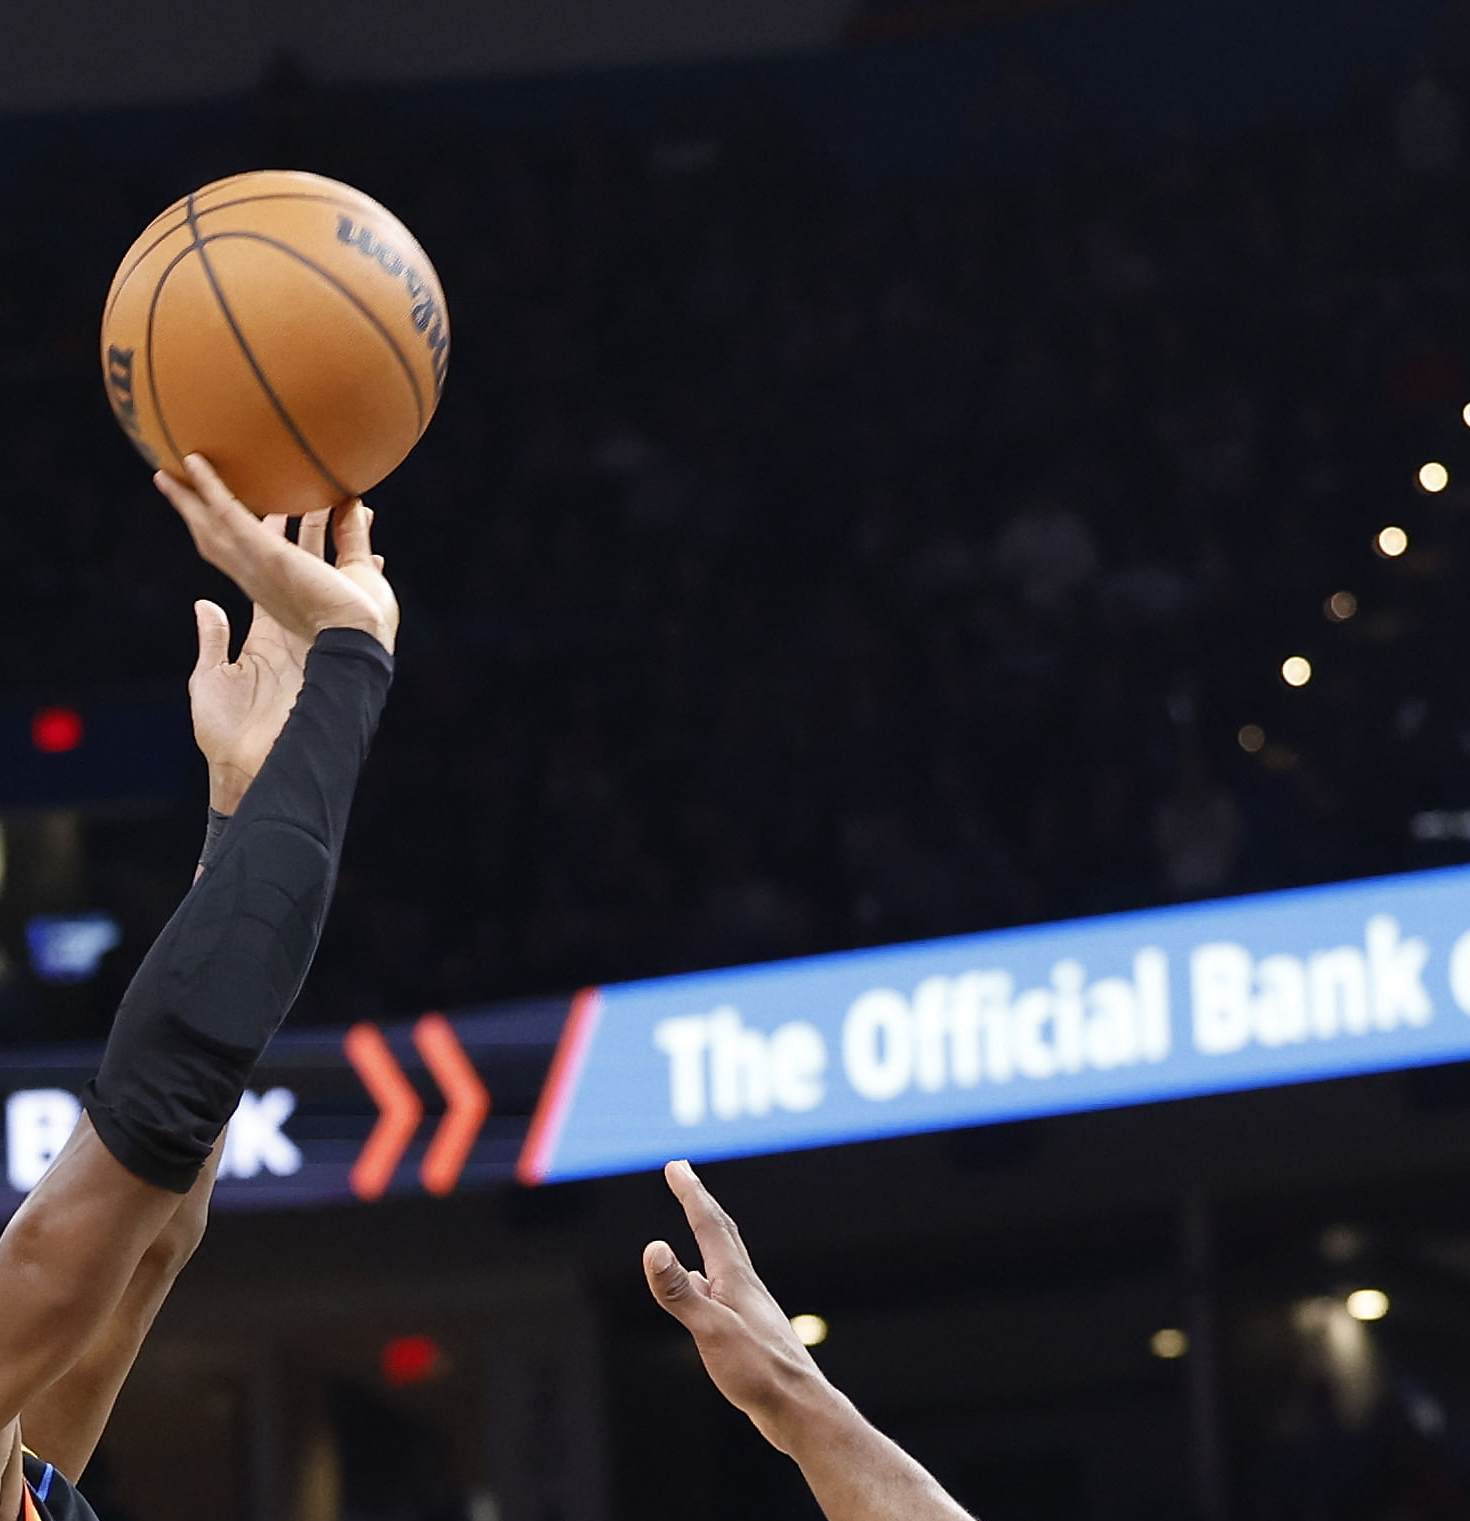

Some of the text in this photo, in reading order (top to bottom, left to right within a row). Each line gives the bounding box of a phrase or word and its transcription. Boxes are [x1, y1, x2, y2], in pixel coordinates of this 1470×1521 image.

[653, 1004, 827, 1126] The
[842, 957, 1173, 1100] Official
[1190, 913, 1433, 1056] Bank
[6, 1088, 301, 1193] BK
